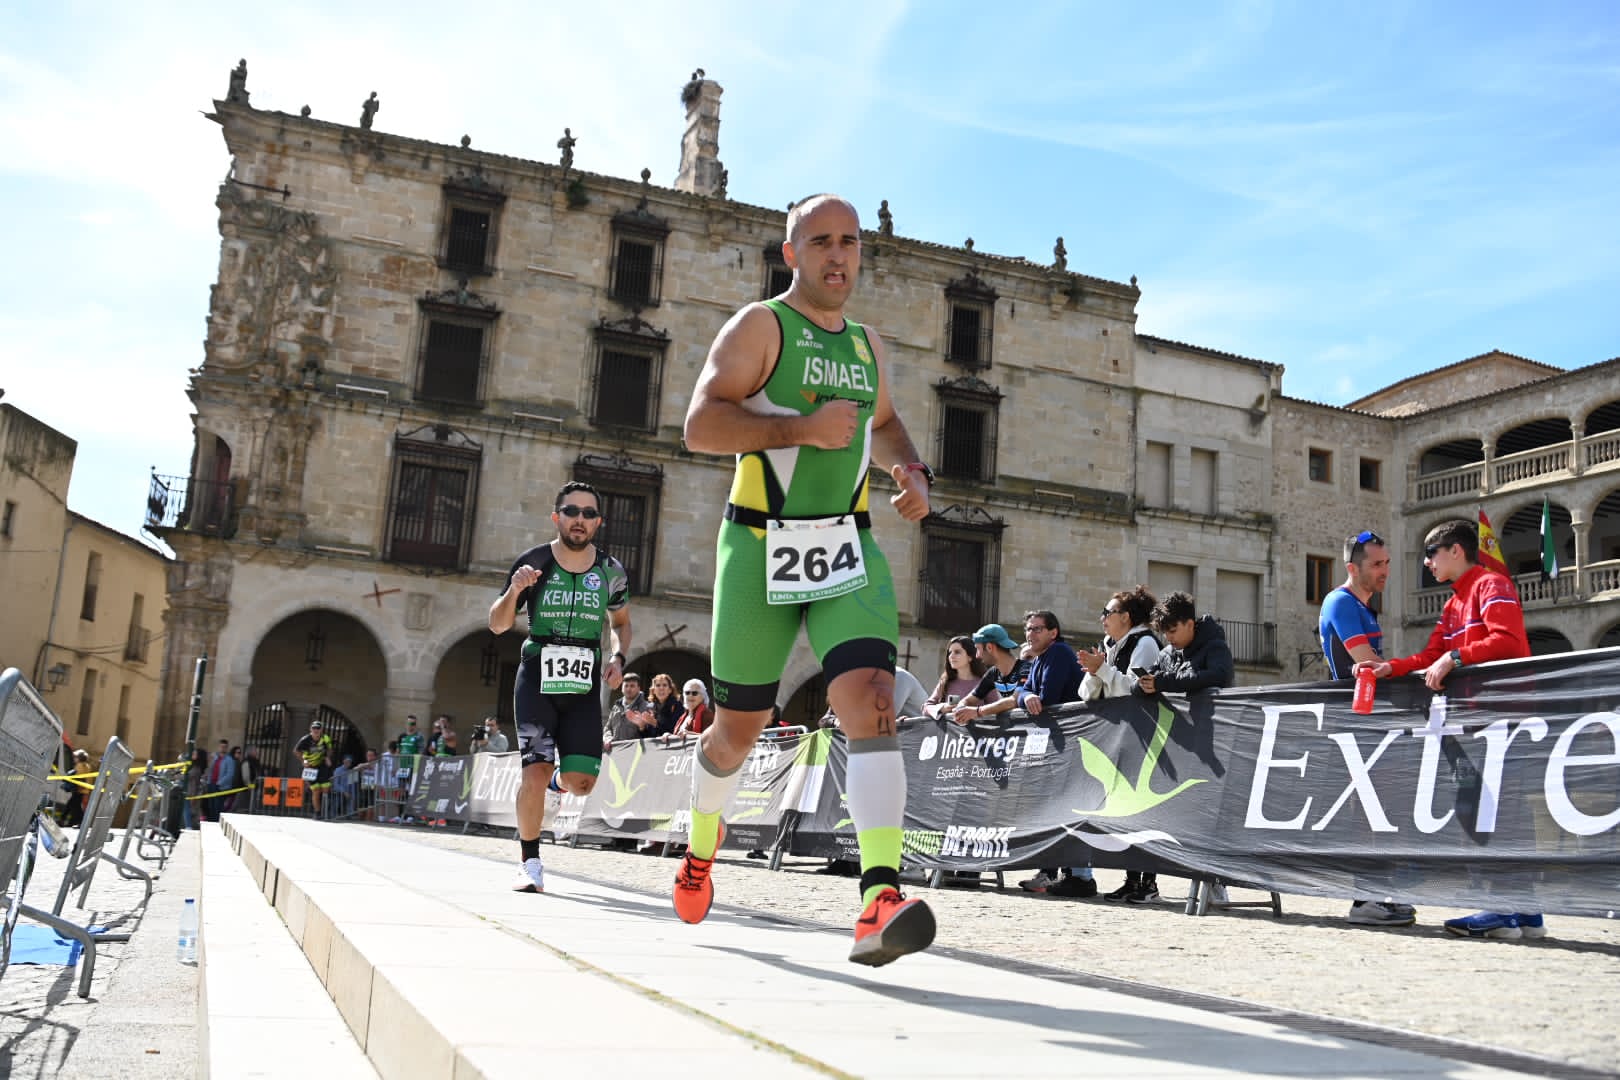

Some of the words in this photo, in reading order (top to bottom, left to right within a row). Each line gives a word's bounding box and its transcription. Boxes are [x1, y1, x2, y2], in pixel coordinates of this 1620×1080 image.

[802, 356, 874, 393] ISMAEL
[771, 541, 859, 582] 264
[542, 590, 600, 609] KEMPES
[772, 592, 794, 601] JUNTA
[798, 592, 808, 600] DE
[544, 657, 591, 680] 1345
[940, 734, 1020, 762] Interreg
[936, 765, 963, 781] España
[970, 765, 1012, 780] Portugal
[1244, 695, 1620, 836] Extre
[941, 825, 1017, 858] DEPORTE
